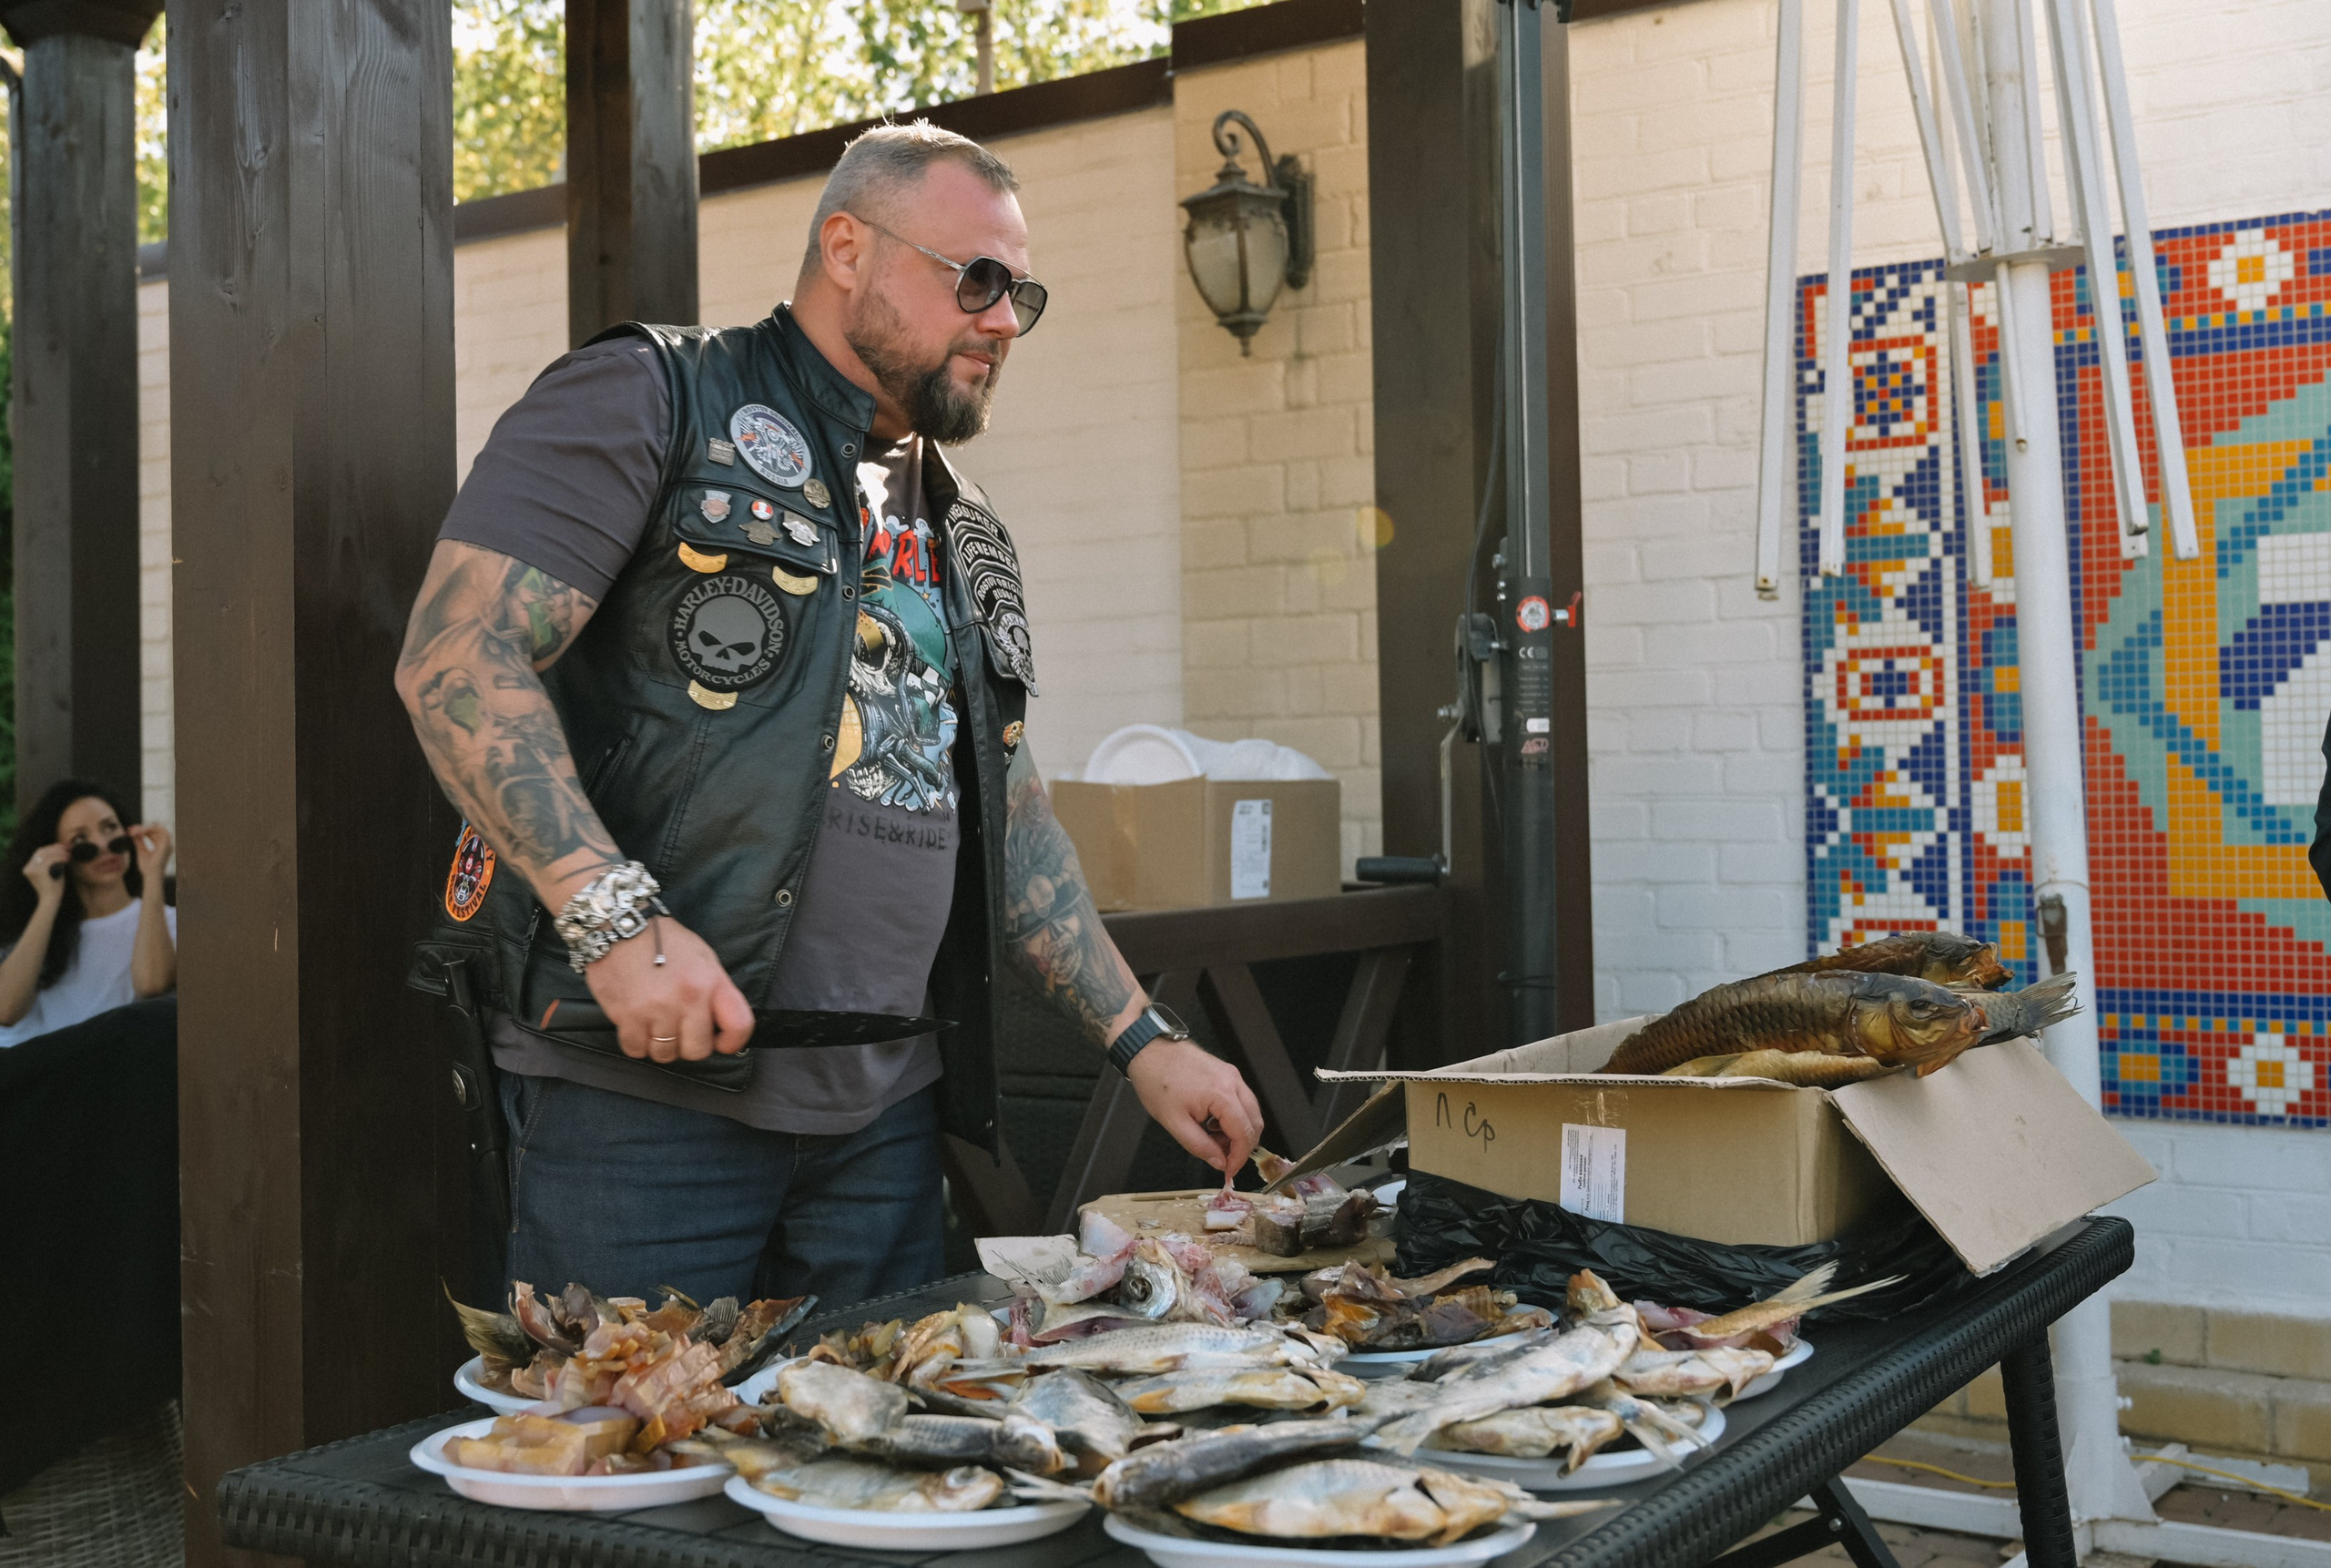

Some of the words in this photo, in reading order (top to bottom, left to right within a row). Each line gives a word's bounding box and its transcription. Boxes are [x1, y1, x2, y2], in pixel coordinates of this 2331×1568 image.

[760, 467, 789, 485] RUSSIA
[992, 588, 1019, 605] RUSSIA
[674, 576, 784, 655] HARLEY-DAVIDSON
[675, 640, 771, 685] MOTORCYCLES
[452, 884, 486, 919] FESTIVAL
